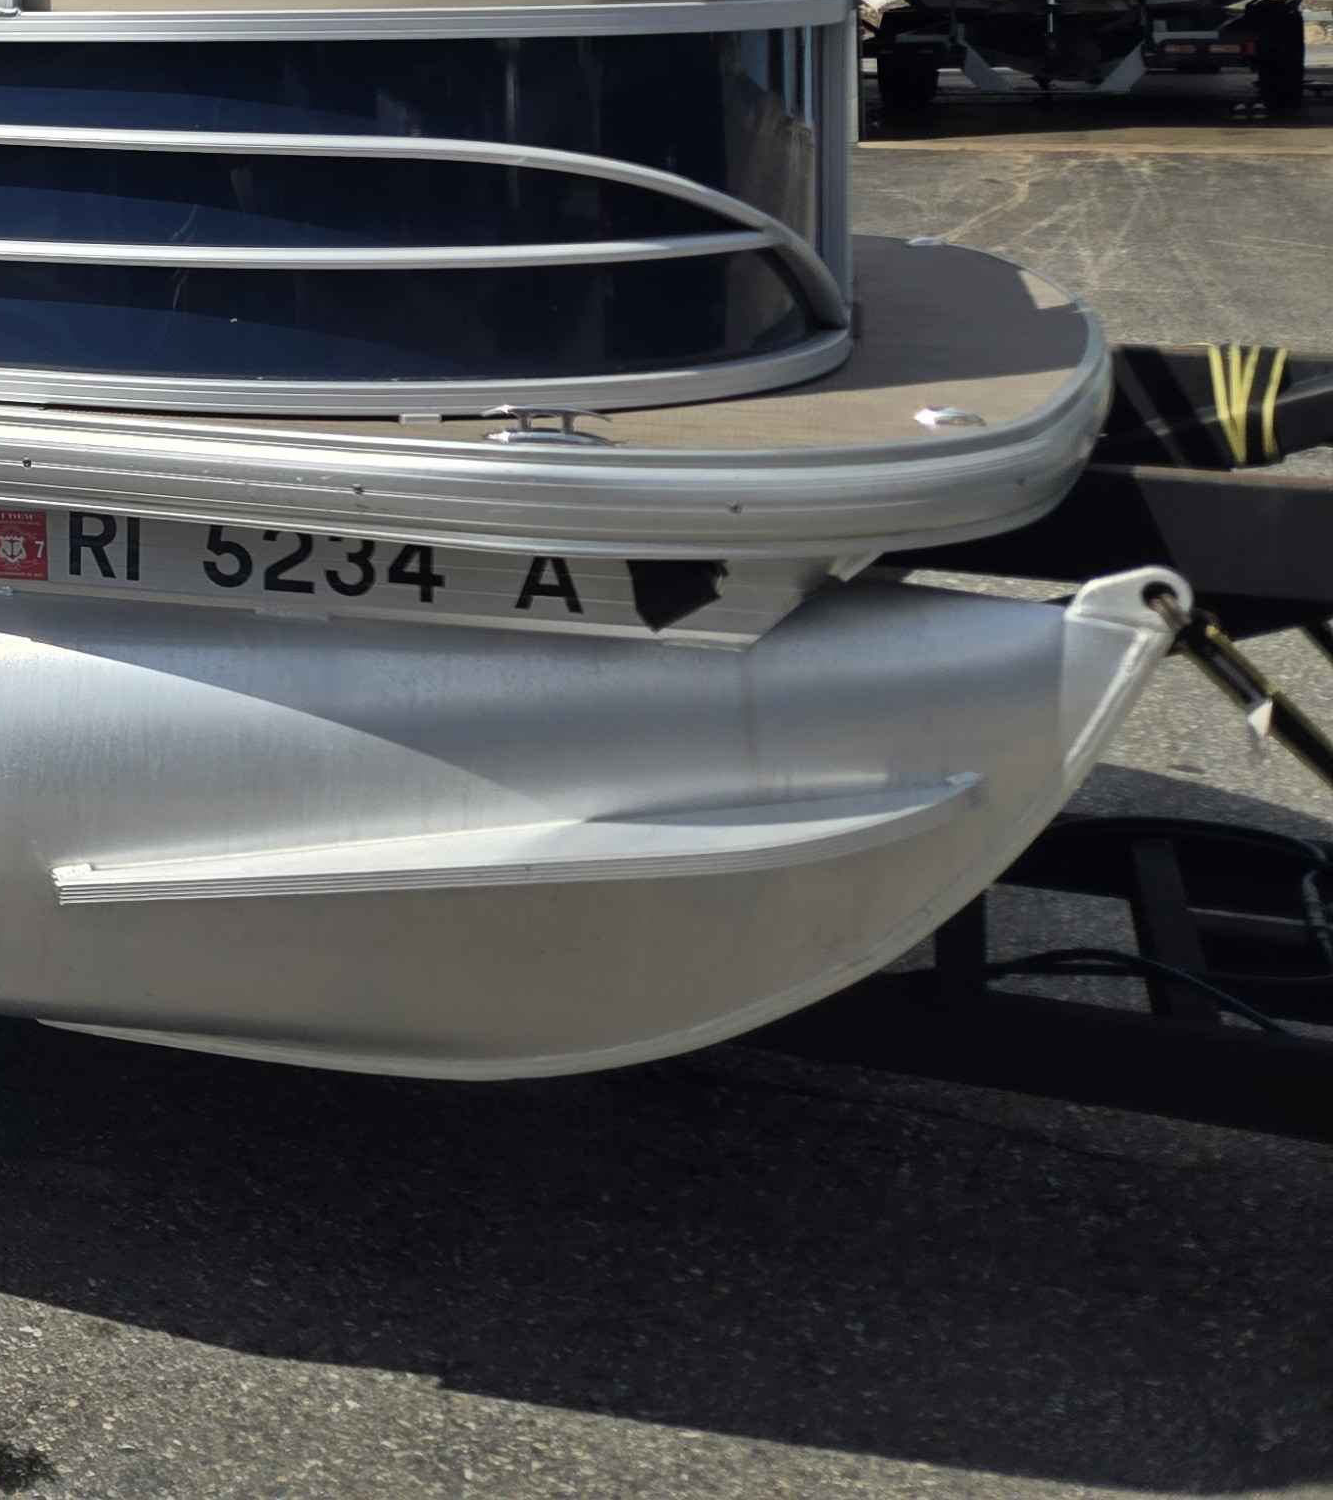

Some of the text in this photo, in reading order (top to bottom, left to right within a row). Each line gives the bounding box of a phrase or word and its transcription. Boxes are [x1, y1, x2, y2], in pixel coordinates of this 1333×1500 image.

[34, 540, 45, 558] 7
[68, 510, 584, 614] RI 5234 A
